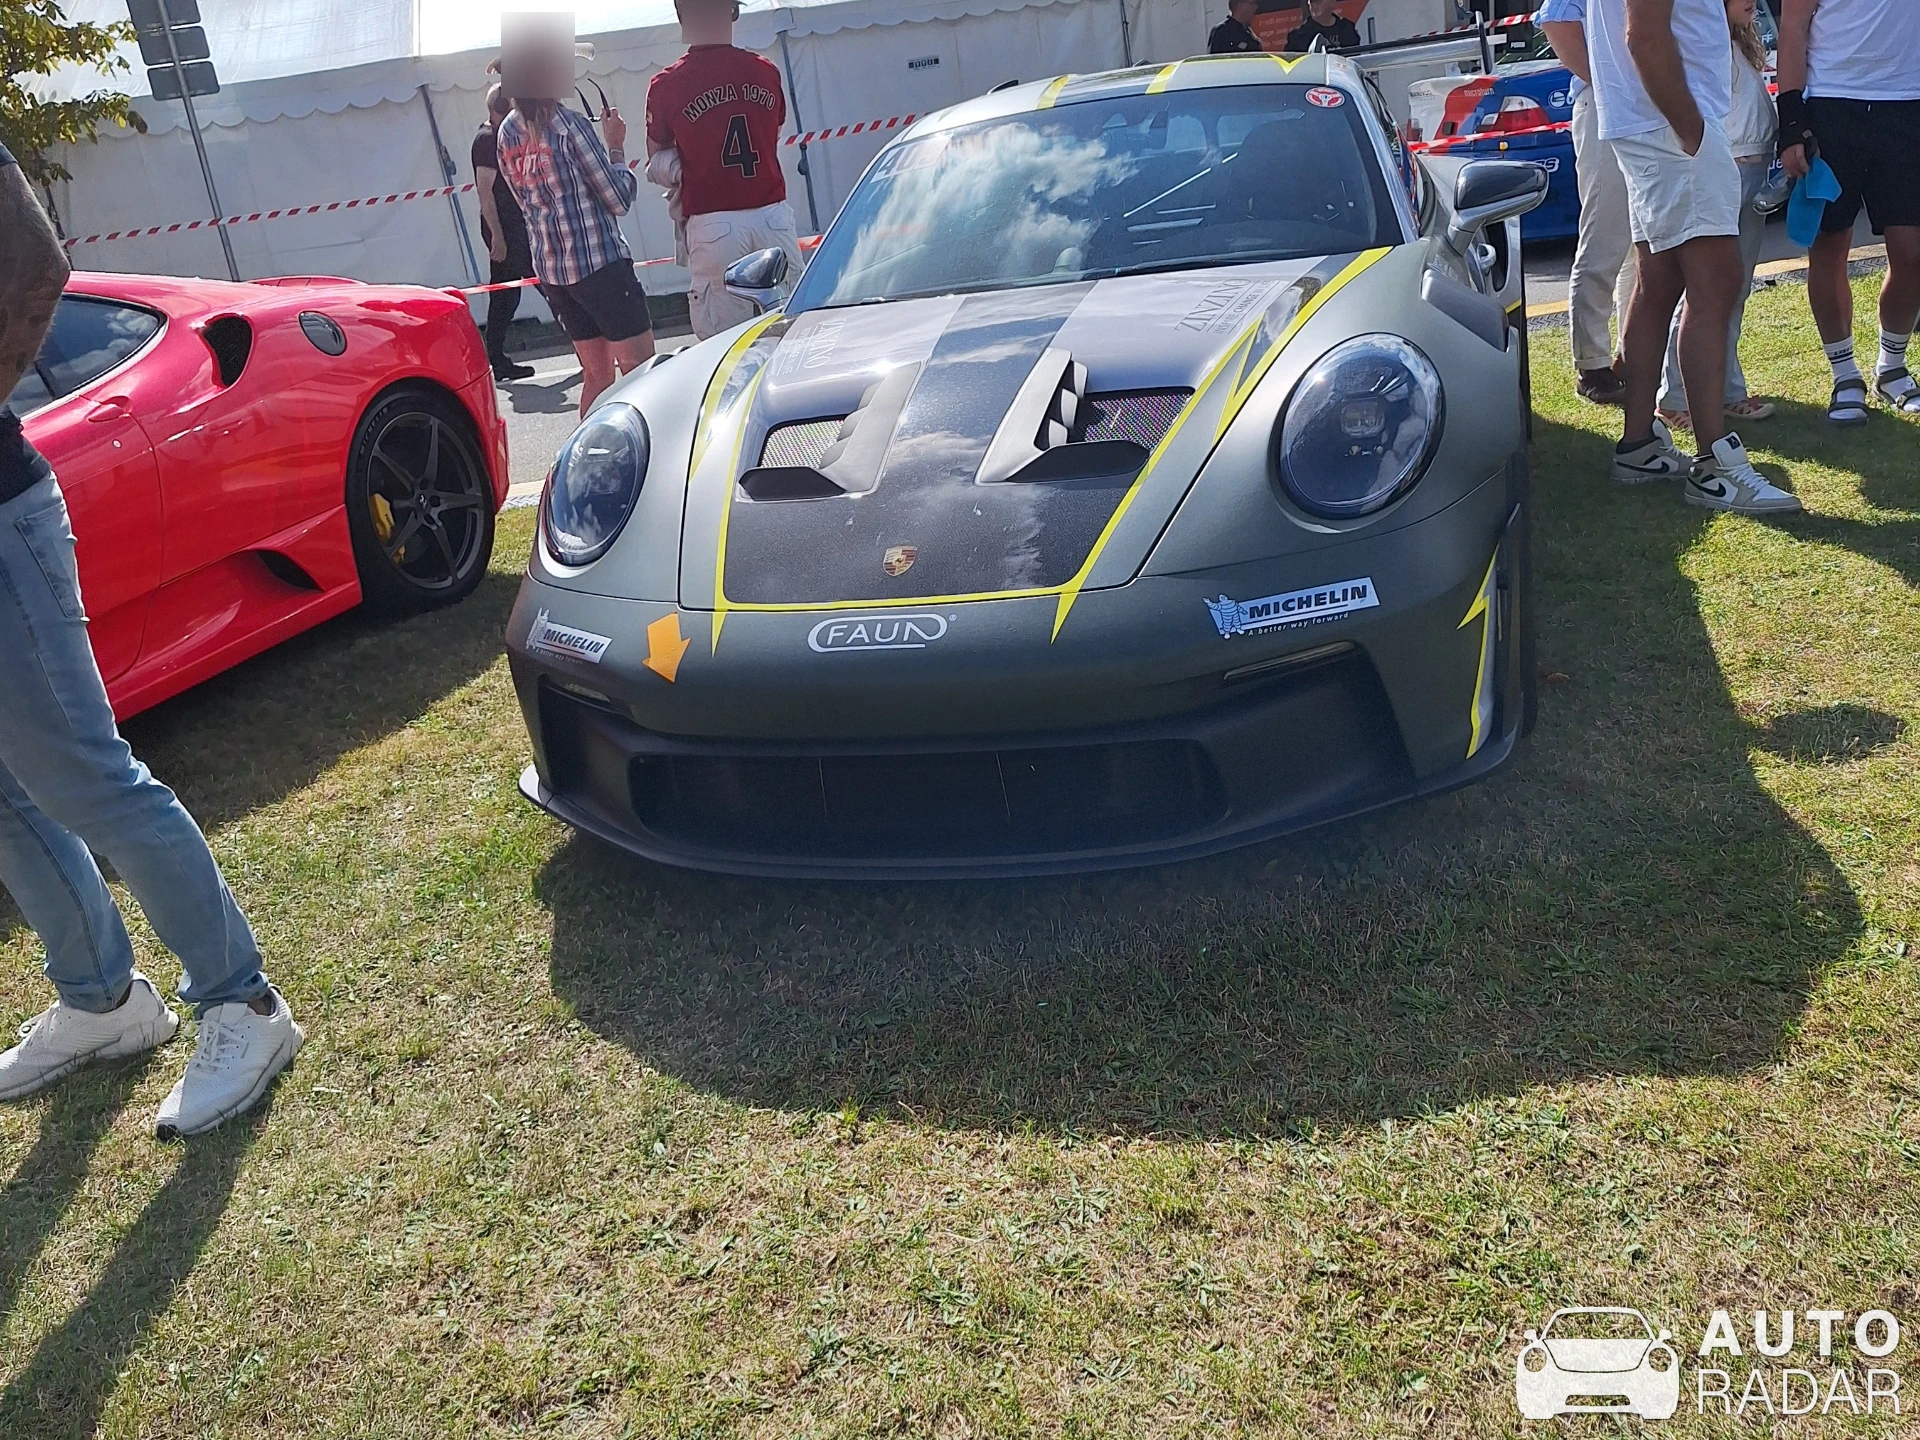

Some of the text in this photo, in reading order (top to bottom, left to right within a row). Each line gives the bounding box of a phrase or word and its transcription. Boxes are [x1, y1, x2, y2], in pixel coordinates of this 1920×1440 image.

[682, 84, 776, 123] MONZA 1970
[1463, 87, 1495, 97] microturn
[720, 113, 761, 179] 4
[1174, 278, 1251, 332] ZINZINO
[1249, 585, 1367, 619] MICHELIN
[827, 621, 948, 645] FAUN
[1248, 611, 1350, 637] A better way forward
[543, 628, 604, 653] MICHELIN
